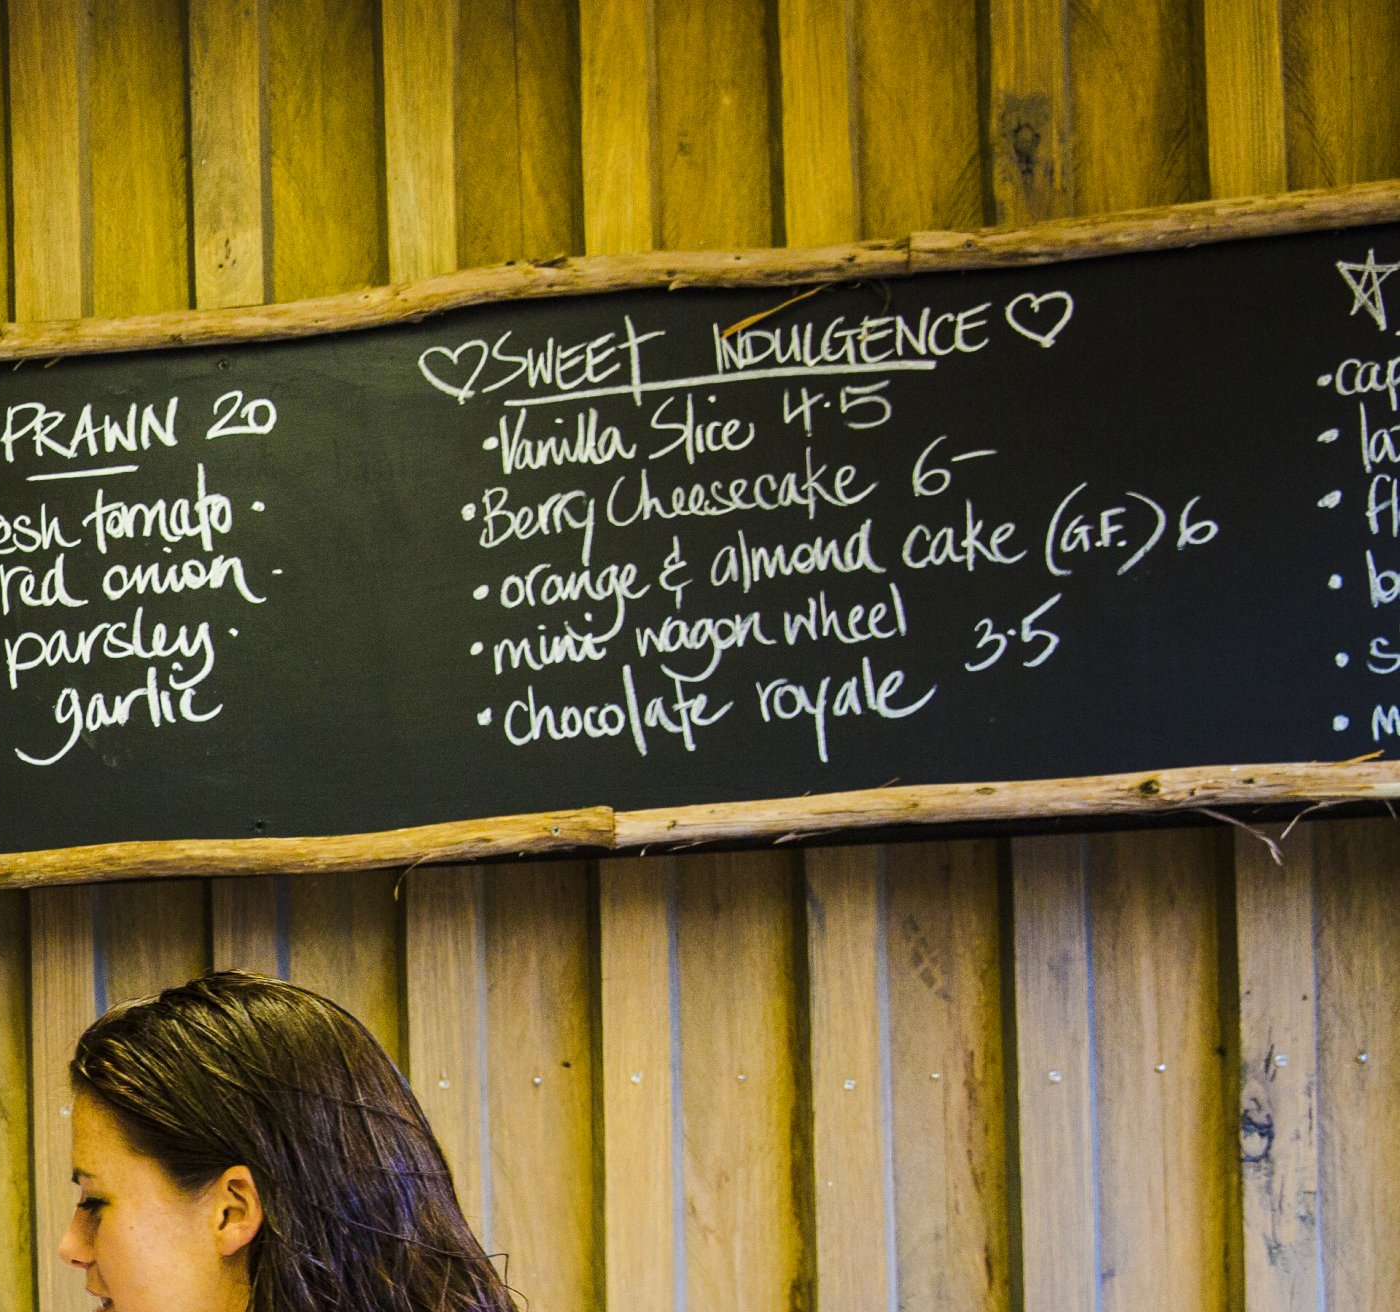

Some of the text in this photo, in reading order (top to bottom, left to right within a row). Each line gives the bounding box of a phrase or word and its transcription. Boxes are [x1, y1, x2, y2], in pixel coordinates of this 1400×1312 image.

[0, 390, 278, 463] PRAWN 20
[499, 380, 893, 476] Vanilla Slice 4.5
[83, 462, 232, 554] tomato
[478, 486, 596, 565] Berry
[605, 446, 880, 528] Cheesecake
[0, 547, 267, 616] red onion
[498, 563, 652, 645] orange
[658, 535, 694, 610] &
[710, 518, 886, 594] almond
[902, 498, 1028, 573] cake
[1176, 494, 1219, 548] 6
[5, 606, 215, 690] parsley
[491, 582, 1064, 683] mini wagon wheel 3.5
[14, 662, 224, 766] garlic
[504, 657, 937, 764] chocolate royale
